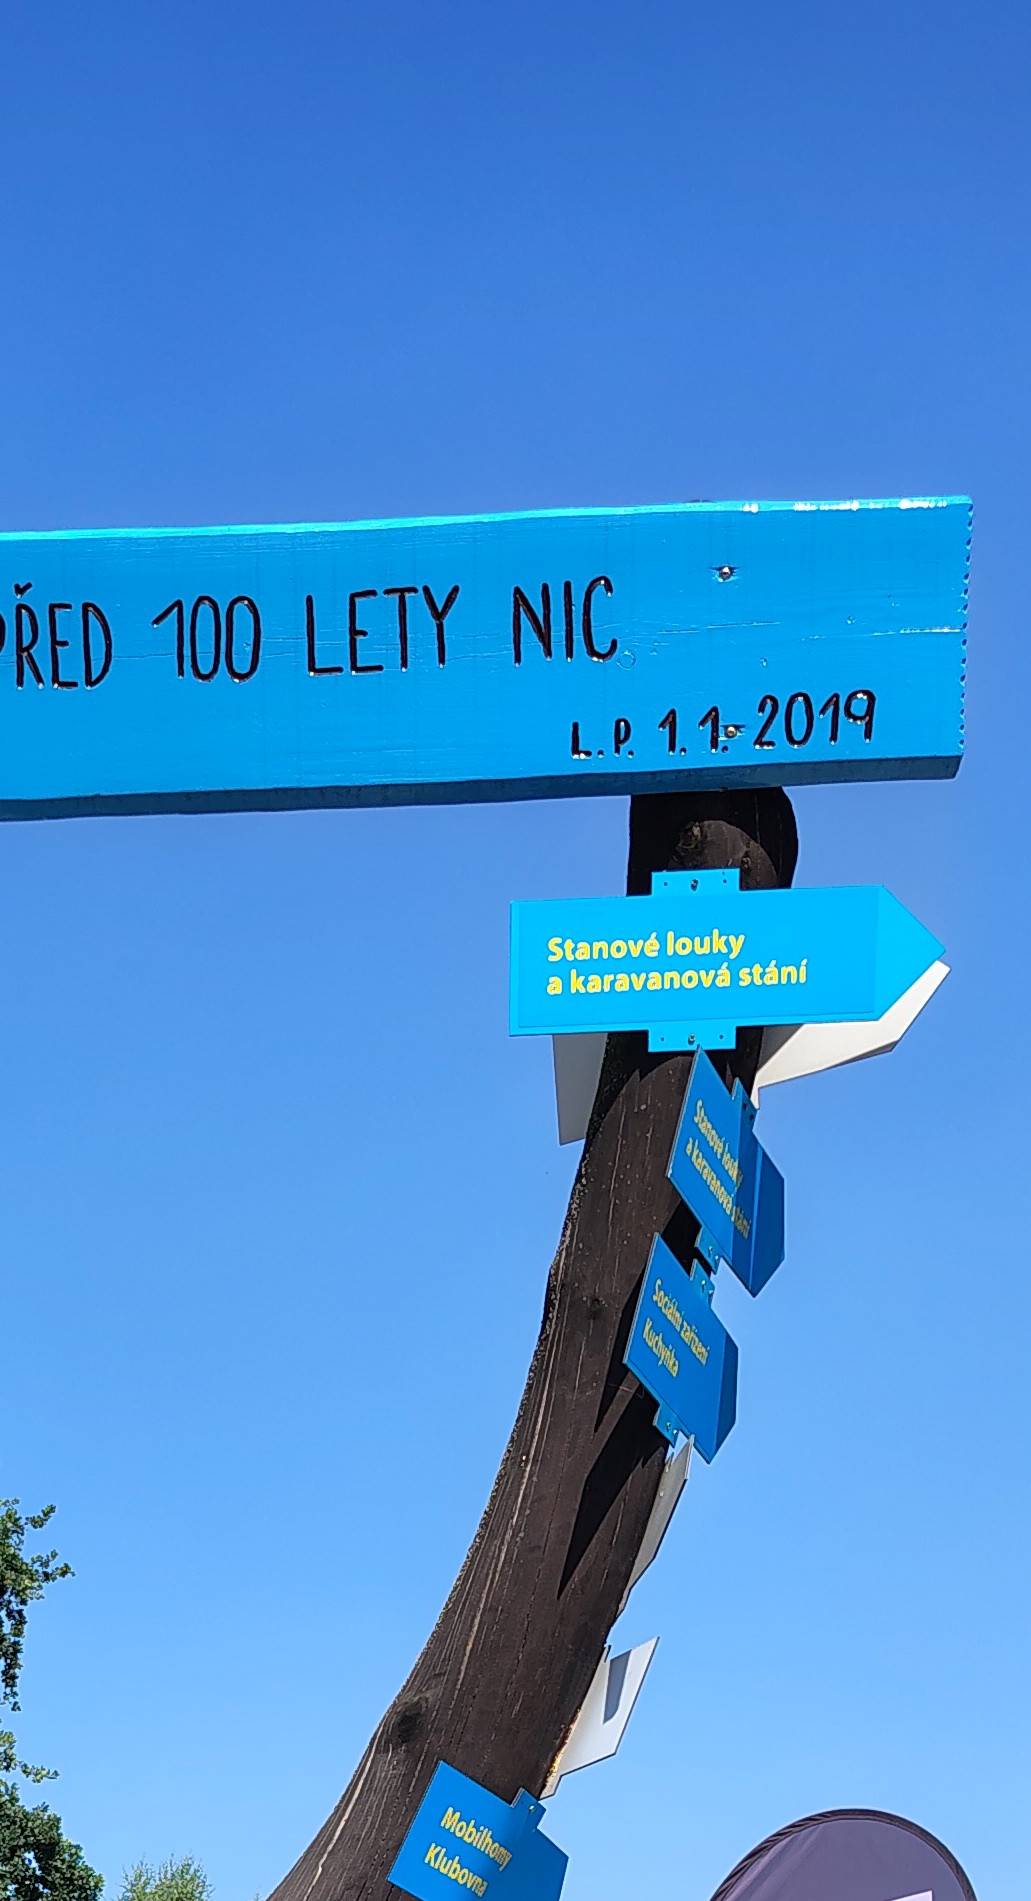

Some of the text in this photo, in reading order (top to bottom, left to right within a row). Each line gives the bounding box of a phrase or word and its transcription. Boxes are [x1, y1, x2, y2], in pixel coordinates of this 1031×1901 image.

[152, 595, 262, 684] 100
[306, 584, 461, 678] LETY
[512, 574, 620, 668] NIC
[753, 689, 877, 750] 2019
[546, 928, 746, 964] Stanové louky
[547, 957, 808, 996] a karavanová stání
[440, 1806, 513, 1873] Mobilhomy
[423, 1842, 489, 1898] Klubovna
